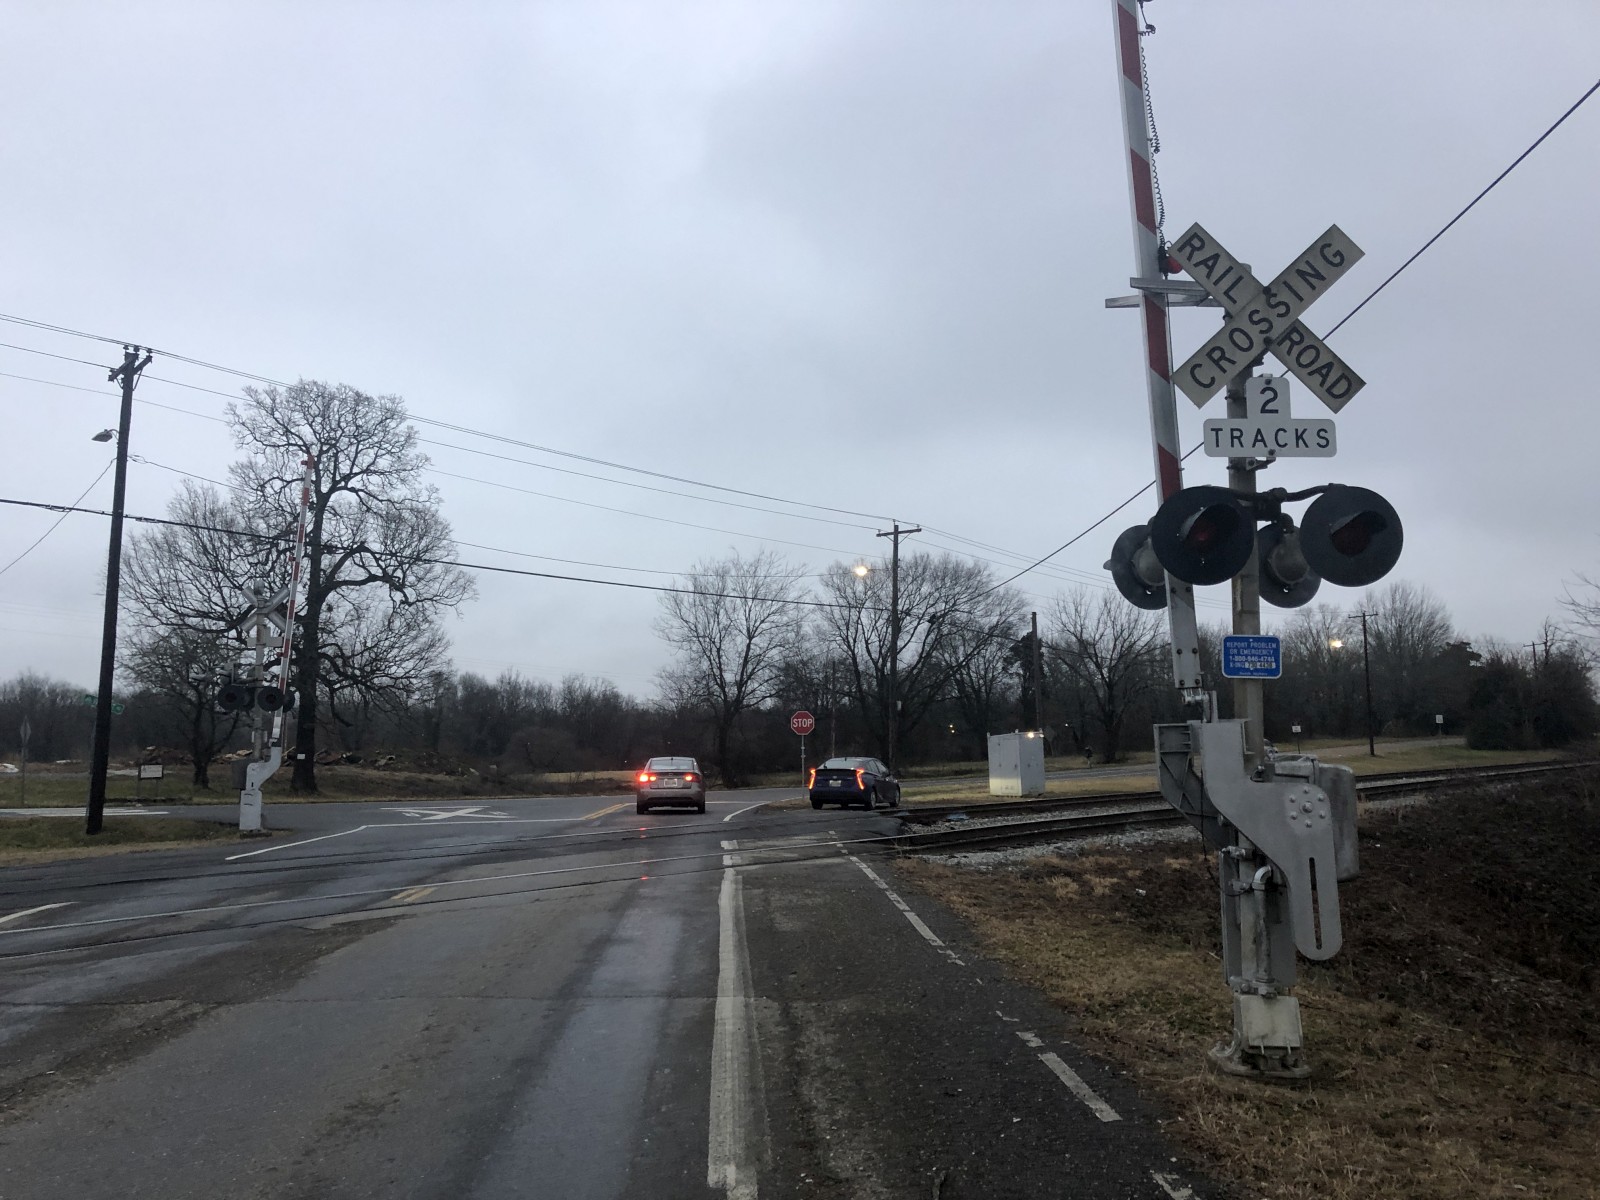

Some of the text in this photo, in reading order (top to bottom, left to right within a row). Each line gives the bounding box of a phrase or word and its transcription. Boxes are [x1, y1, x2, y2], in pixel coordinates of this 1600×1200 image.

[1177, 232, 1244, 304] RAIL
[1189, 243, 1345, 389] CROSSING
[1276, 326, 1352, 400] ROAD
[1260, 387, 1279, 414] 2
[1211, 427, 1330, 449] TRACKS
[792, 719, 813, 728] STOP
